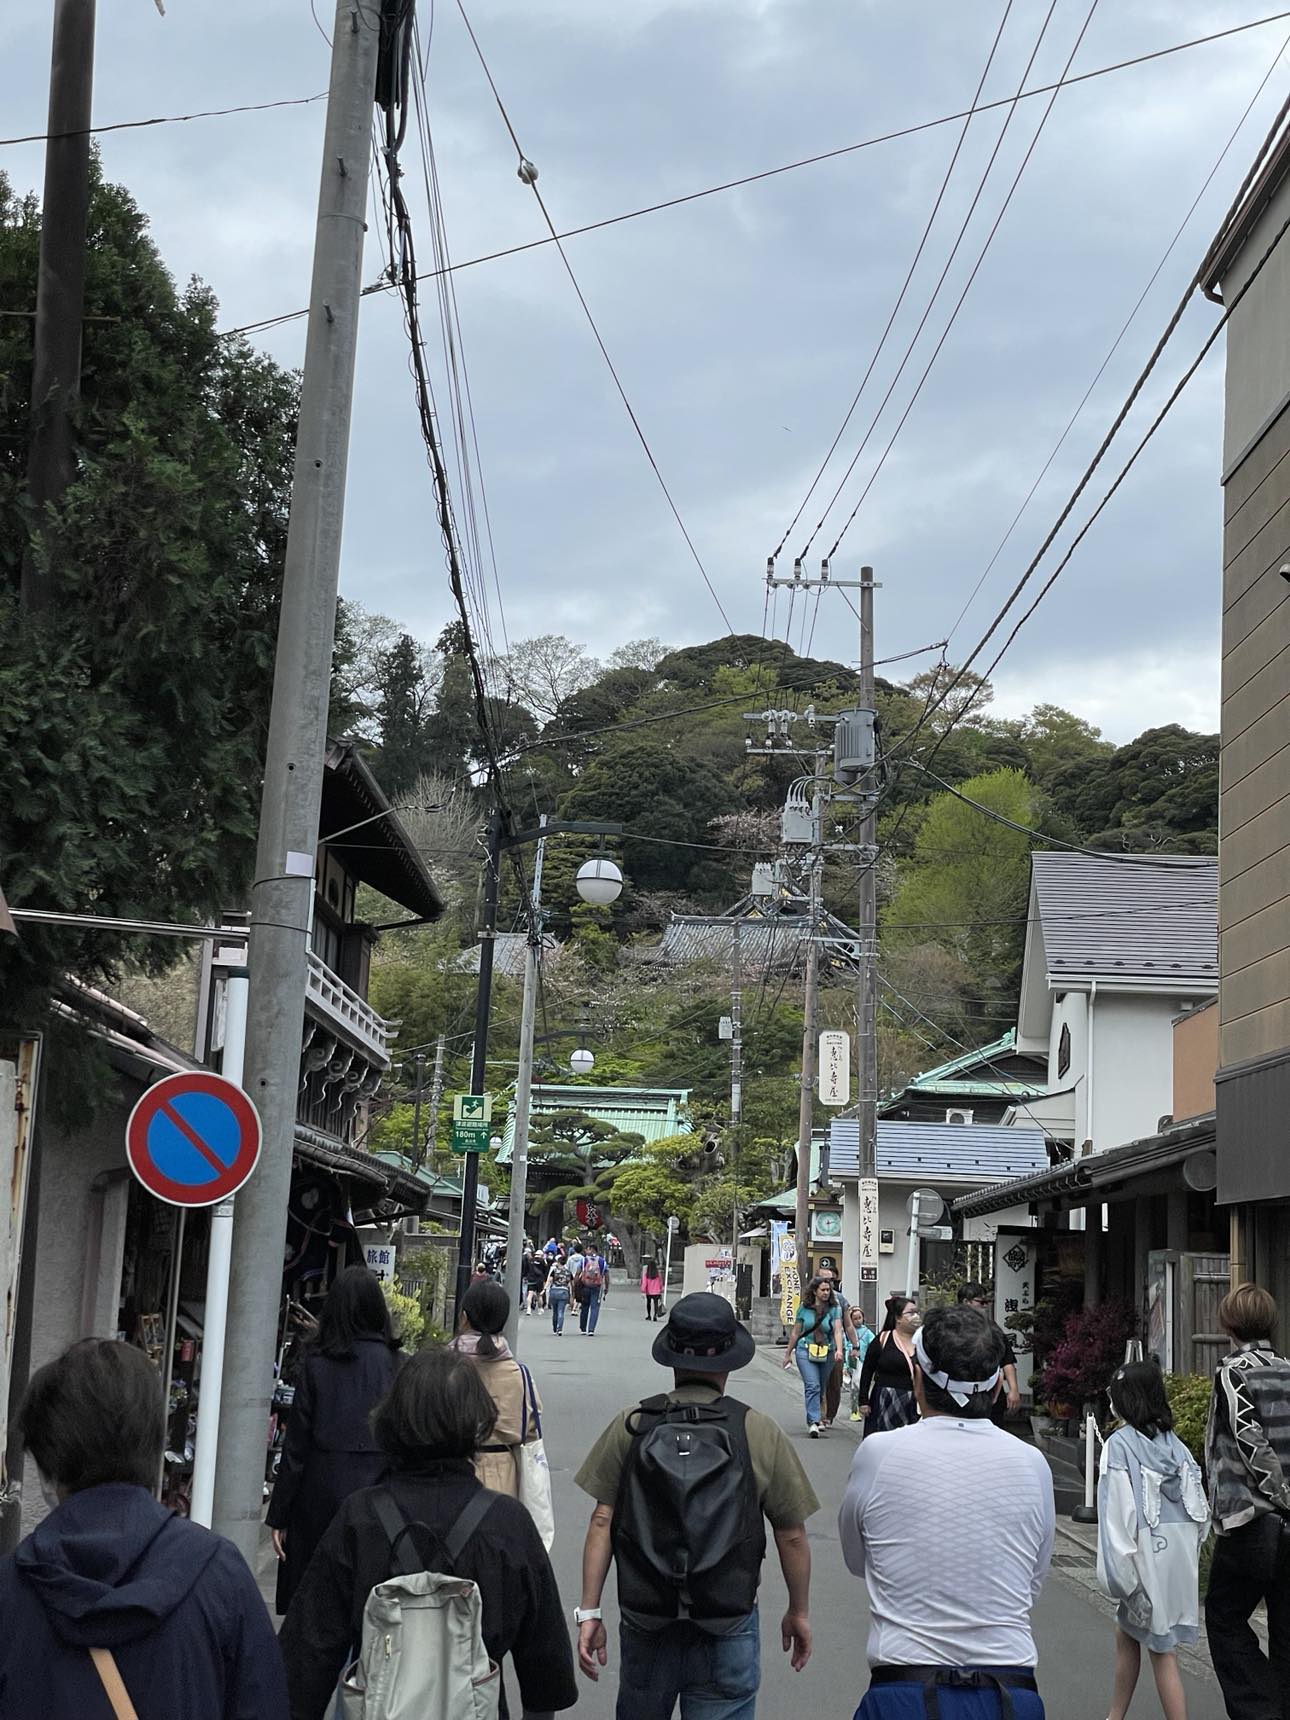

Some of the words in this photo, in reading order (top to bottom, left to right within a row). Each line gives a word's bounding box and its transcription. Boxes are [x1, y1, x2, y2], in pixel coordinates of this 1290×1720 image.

[455, 1130, 476, 1138] 180m
[367, 1249, 390, 1265] 旅館
[785, 1266, 794, 1323] EXCHANGE
